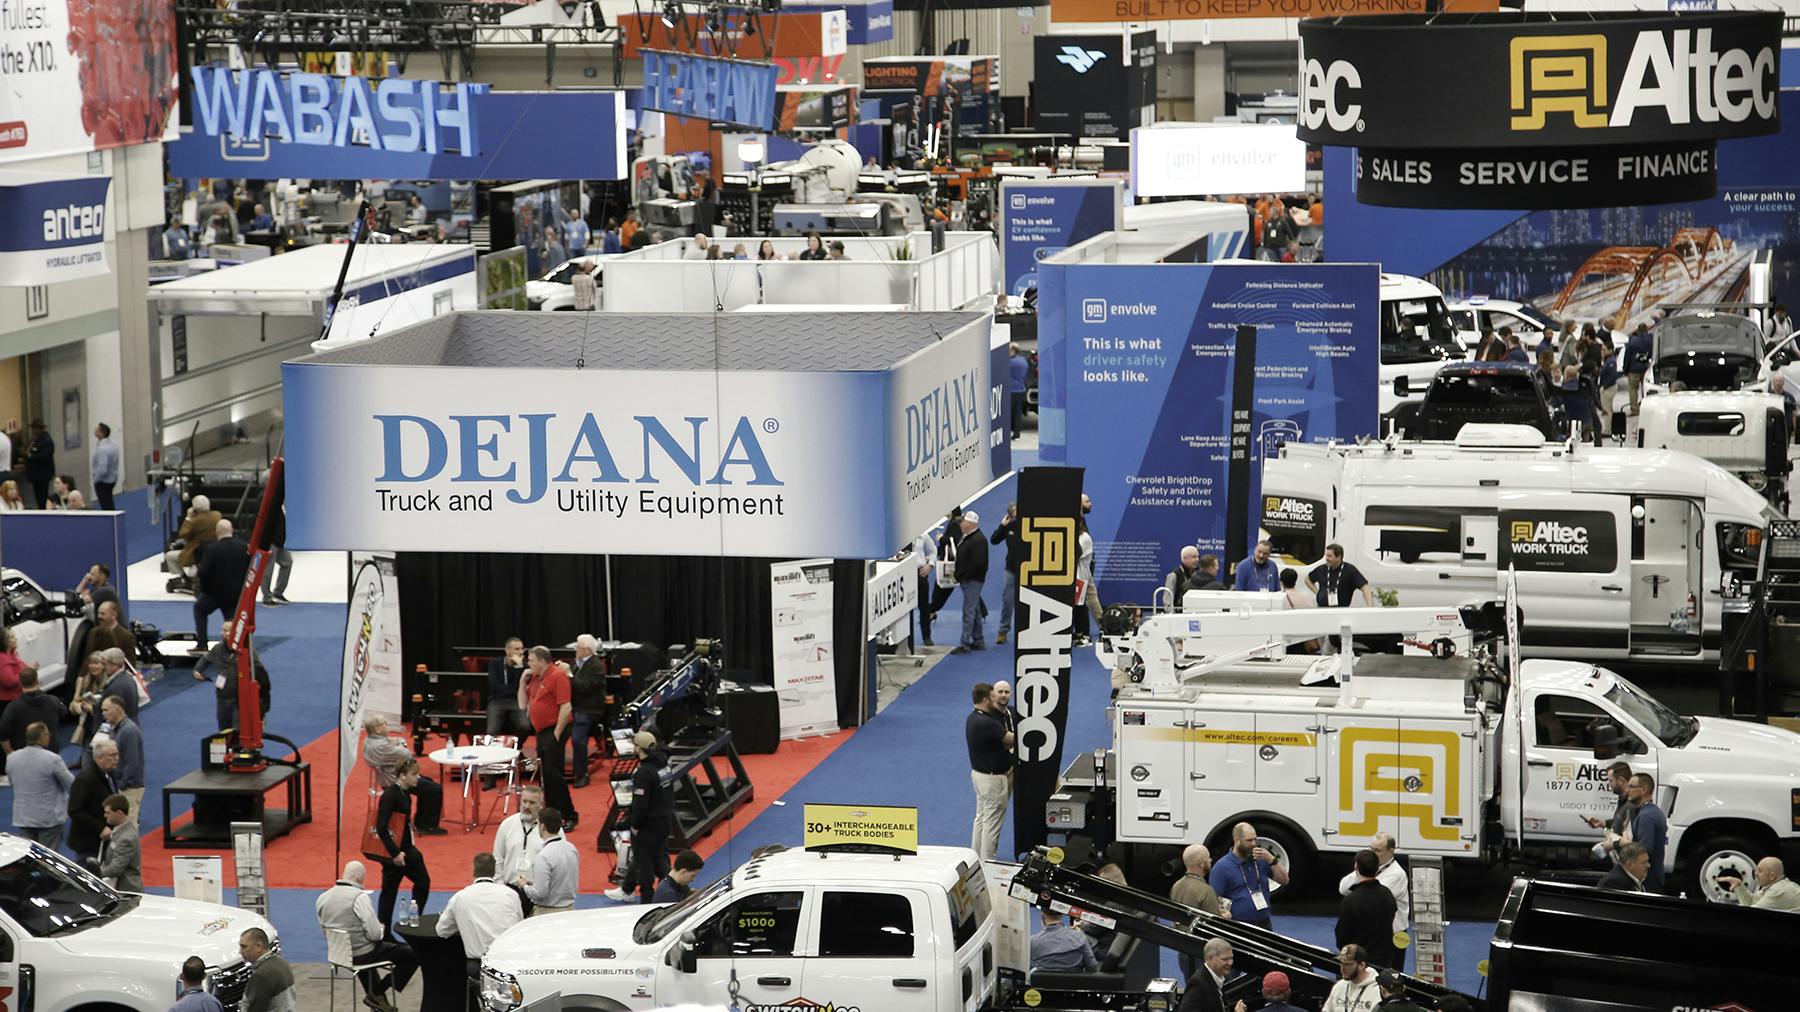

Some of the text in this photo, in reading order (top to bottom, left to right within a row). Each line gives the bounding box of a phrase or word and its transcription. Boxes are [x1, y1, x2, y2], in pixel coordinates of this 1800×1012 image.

[1116, 0, 1422, 16] BUILT TO KEEP YOU WORKING
[1, 40, 58, 74] the X10.
[865, 67, 918, 77] LIGHTING
[1608, 28, 1776, 128] Altec
[1372, 158, 1433, 185] SALES
[1459, 159, 1589, 185] SERVICE
[1617, 150, 1708, 181] FINANCE
[1724, 192, 1796, 203] A clear path to
[1730, 204, 1796, 213] your success.
[43, 204, 104, 242] anteo
[1036, 218, 1053, 226] what
[1087, 303, 1157, 317] gm envolve
[1212, 302, 1236, 310] Adaptive
[1083, 338, 1162, 350] This is what
[1083, 354, 1167, 368] driver safety
[1083, 370, 1149, 382] looks like.
[906, 368, 979, 478] DEJANA
[906, 478, 921, 502] Truck
[921, 467, 931, 494] and
[955, 437, 980, 472] Equipment
[1126, 475, 1212, 486] Chevrolet BrightDrop
[1142, 486, 1212, 496] Safety and Driver
[375, 489, 784, 519] Truck and Utility Equipment
[1131, 497, 1213, 506] Assistance Features
[1280, 498, 1313, 514] Altec
[1266, 511, 1313, 521] WORK TRUCK
[1533, 521, 1588, 543] Altec
[1511, 543, 1589, 555] WORK TRUCK
[875, 576, 905, 616] ALLEGIS
[1017, 585, 1073, 762] Altec
[1204, 733, 1298, 743] www.altec.com/careers
[1576, 764, 1609, 782] Alte
[1546, 781, 1612, 792] 1877 GO AL
[807, 822, 914, 833] 30+ INTERCHANGEABLE
[834, 829, 894, 838] TRUCK BODIES
[739, 918, 776, 928] $1000
